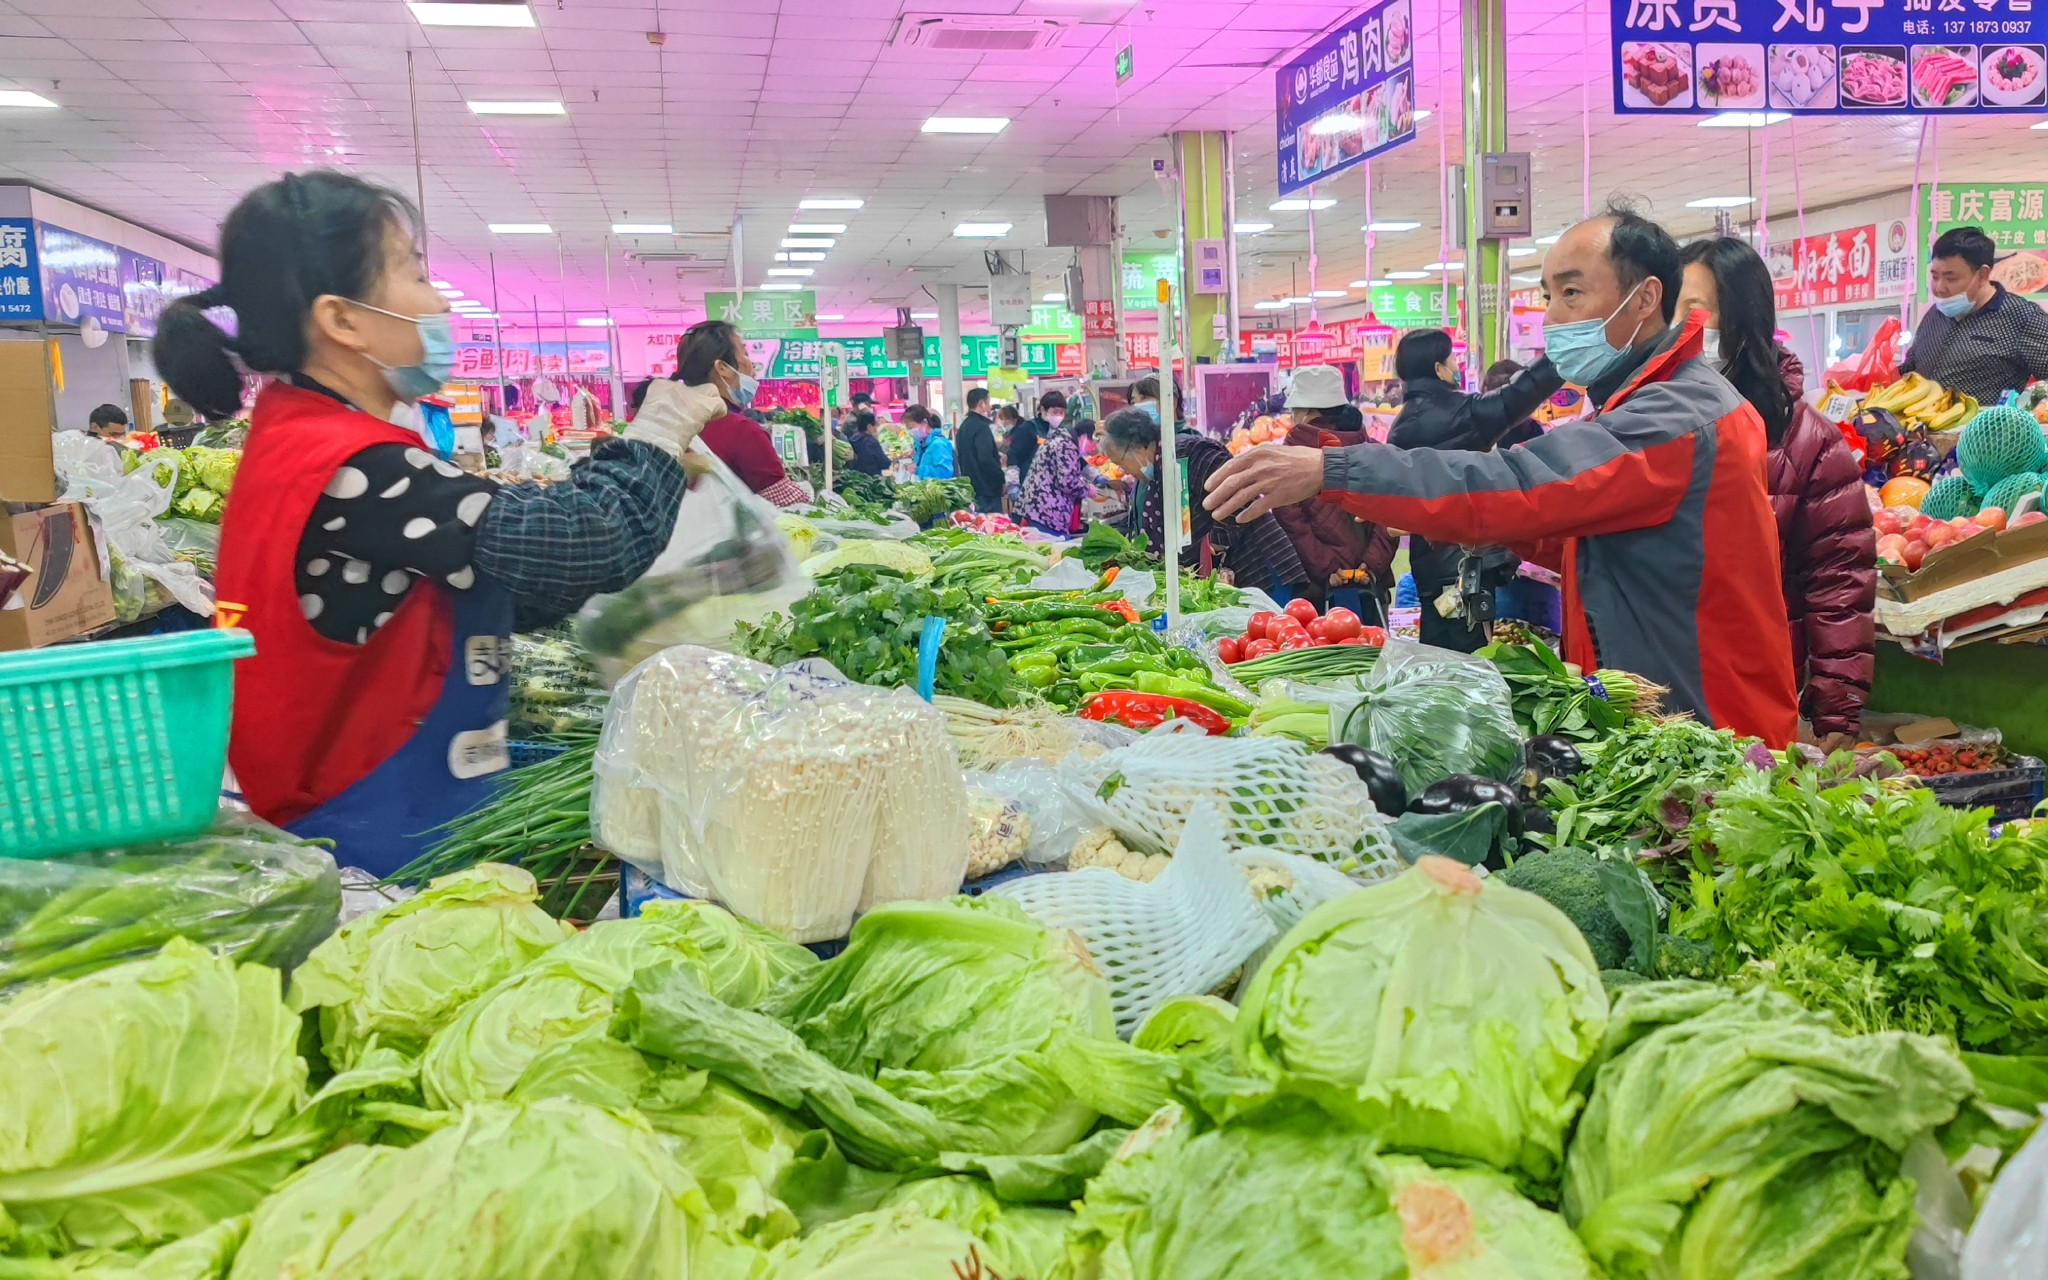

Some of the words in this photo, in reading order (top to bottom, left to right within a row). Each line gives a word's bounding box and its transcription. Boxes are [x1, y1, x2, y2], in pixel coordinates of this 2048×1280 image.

[1943, 21, 1966, 34] 137
[1969, 21, 1999, 34] 1873
[2001, 21, 2032, 34] 0937
[1339, 16, 1382, 91] 鸡肉
[1308, 50, 1339, 89] 华都食品
[1279, 134, 1296, 150] chicken
[1281, 155, 1297, 184] 清真
[1927, 189, 2045, 222] 重庆富源
[0, 276, 31, 296] 价廉
[9, 304, 32, 313] 5472
[719, 300, 805, 323] 水果区
[1085, 301, 1113, 316] 调料
[1377, 291, 1447, 313] 主食区
[984, 345, 1046, 364] 安通道
